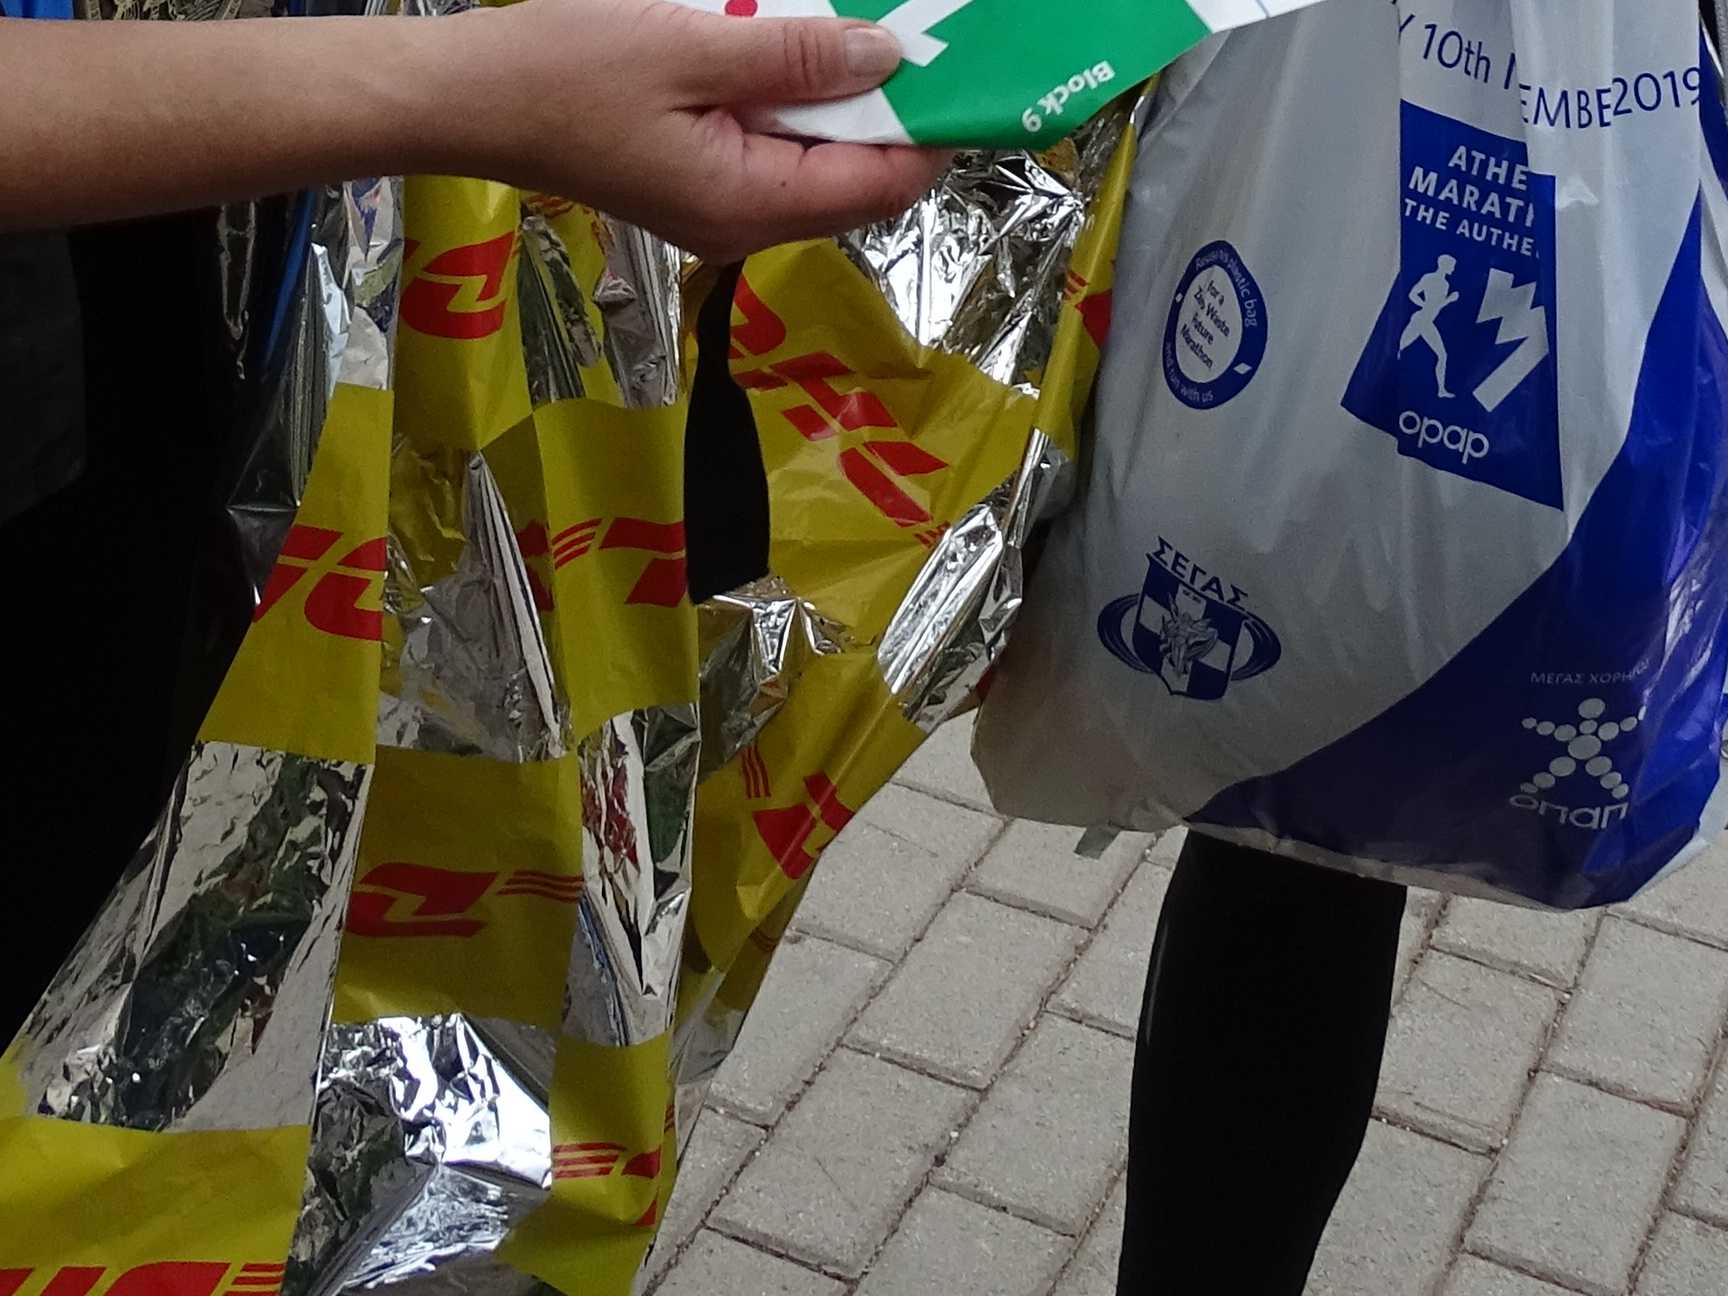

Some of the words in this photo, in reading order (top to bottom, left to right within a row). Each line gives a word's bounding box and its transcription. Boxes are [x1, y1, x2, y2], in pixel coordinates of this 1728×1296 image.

[1037, 60, 1116, 115] Block
[1422, 23, 1491, 84] 10th
[1612, 67, 1700, 117] 2019
[1448, 145, 1529, 191] ATHE
[1408, 165, 1535, 228] MARAT
[1404, 198, 1450, 230] THE
[1456, 219, 1539, 259] AUTHE
[1205, 302, 1231, 337] Waste
[1244, 298, 1258, 328] bag
[1181, 323, 1214, 370] Marathon
[1201, 390, 1214, 403] us
[1399, 410, 1489, 464] opap
[1152, 535, 1248, 612] ΣΕΓΑΣ
[1530, 671, 1585, 685] ΜΕΓΑΣ
